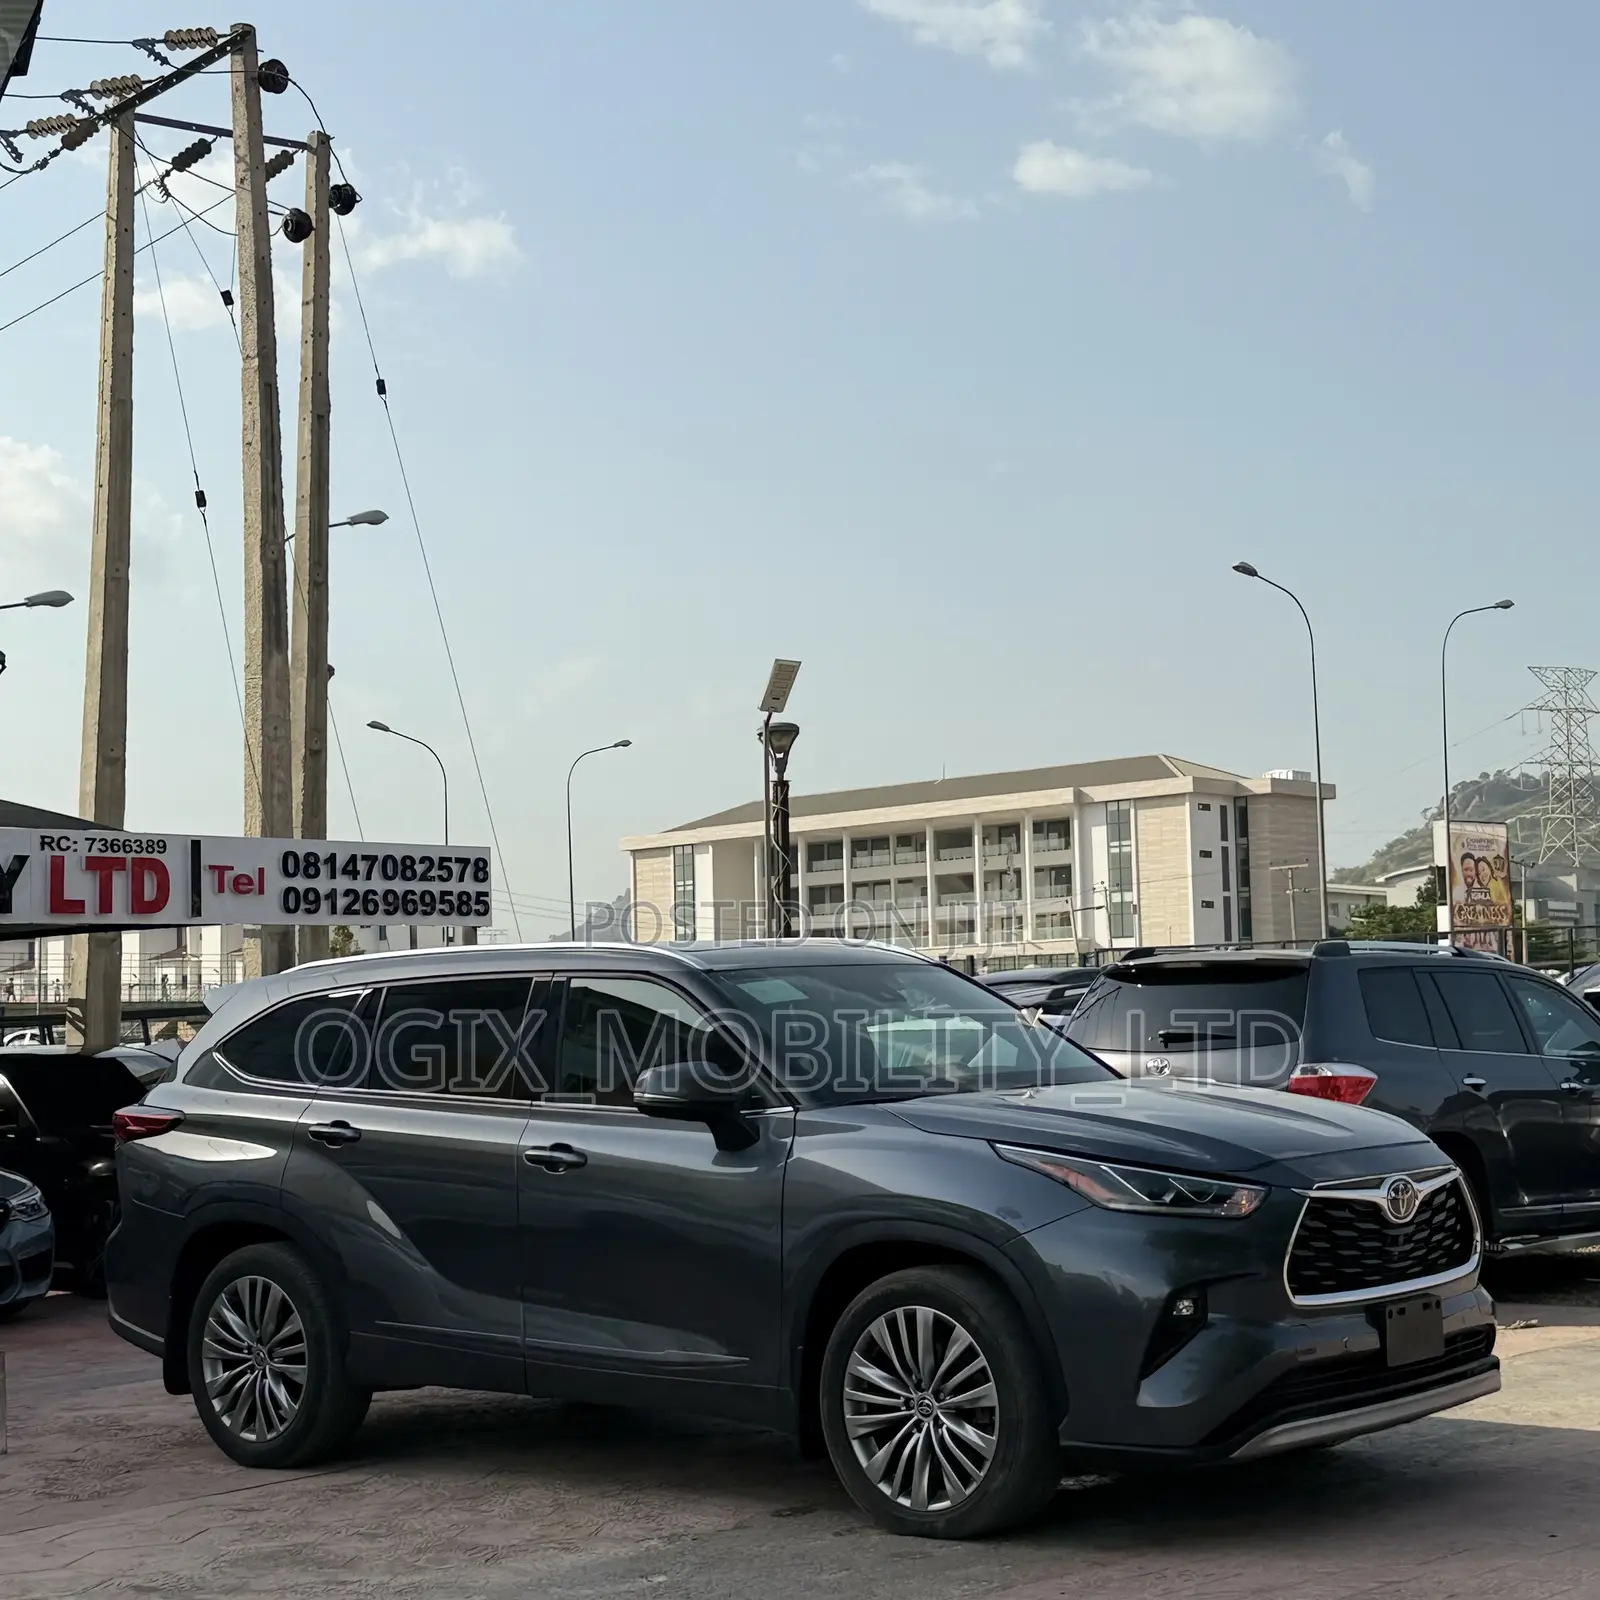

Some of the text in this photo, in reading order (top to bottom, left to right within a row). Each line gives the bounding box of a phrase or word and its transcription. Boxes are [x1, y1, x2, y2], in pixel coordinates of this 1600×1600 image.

[40, 835, 168, 854] RC: 7366389
[208, 864, 266, 896] Tel
[281, 850, 490, 883] 08147082578
[50, 855, 170, 914] LTD
[281, 886, 490, 917] 09126969585
